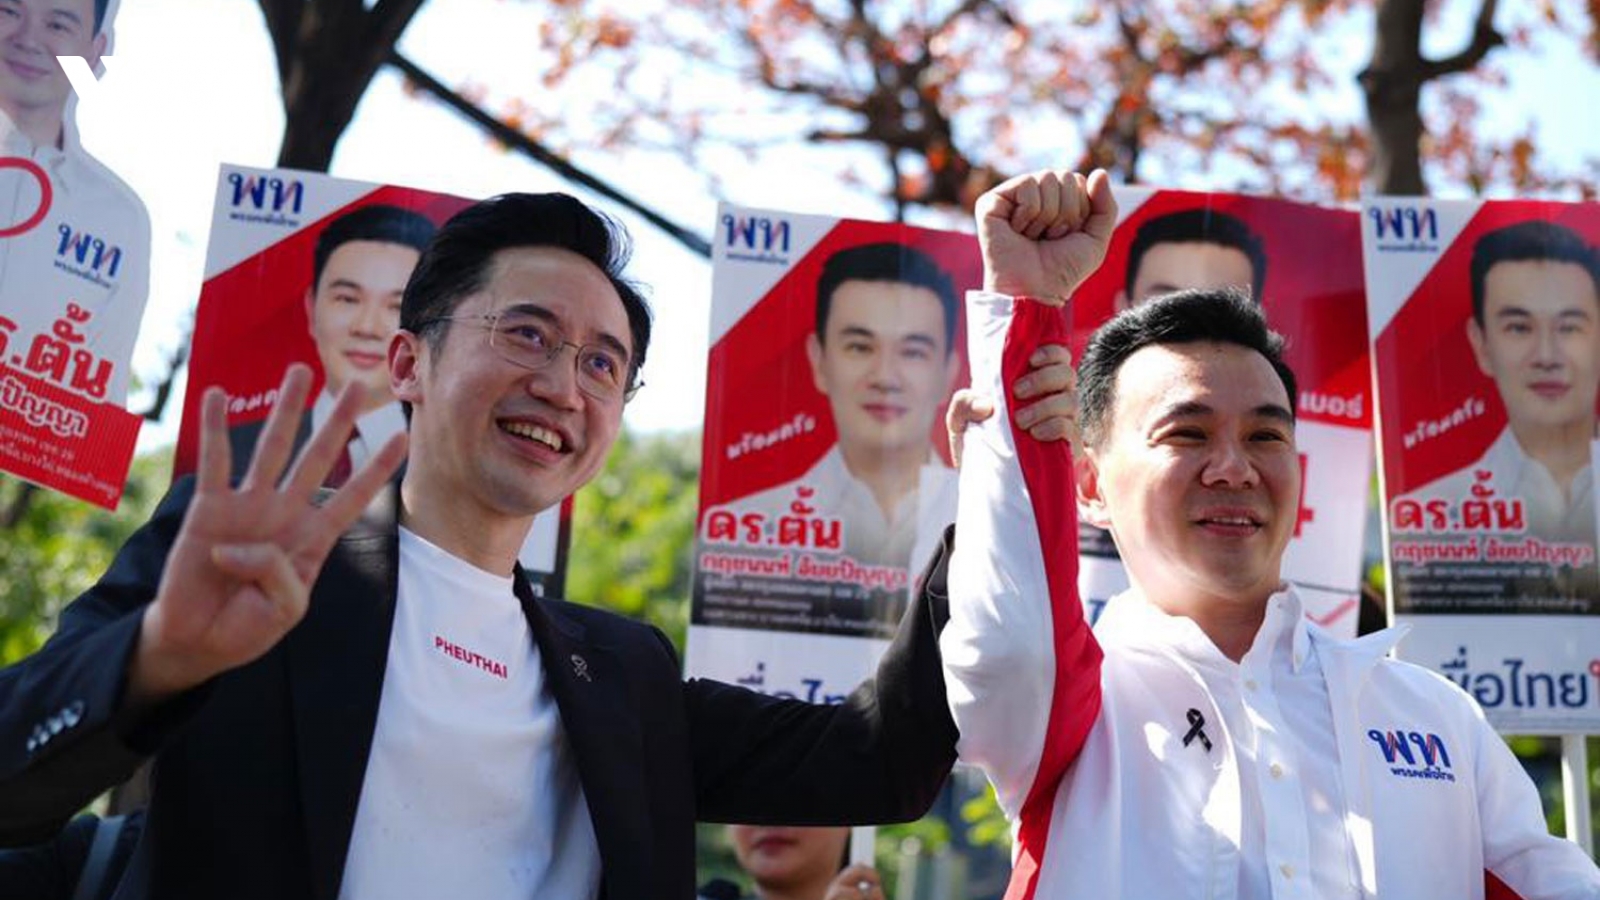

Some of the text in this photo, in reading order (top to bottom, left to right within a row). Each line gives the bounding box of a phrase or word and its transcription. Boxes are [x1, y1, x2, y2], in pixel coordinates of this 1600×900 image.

[227, 173, 304, 215] พท
[721, 213, 790, 253] พท
[1368, 206, 1438, 240] พท
[57, 222, 123, 277] พท
[0, 376, 88, 438] ปัญญา
[706, 487, 842, 549] ดร.ตั้น
[1393, 469, 1525, 531] ดร.ตั้น
[434, 635, 508, 679] PHEUTHAI
[1441, 646, 1600, 709] ื่อไทย
[1367, 729, 1452, 768] พท
